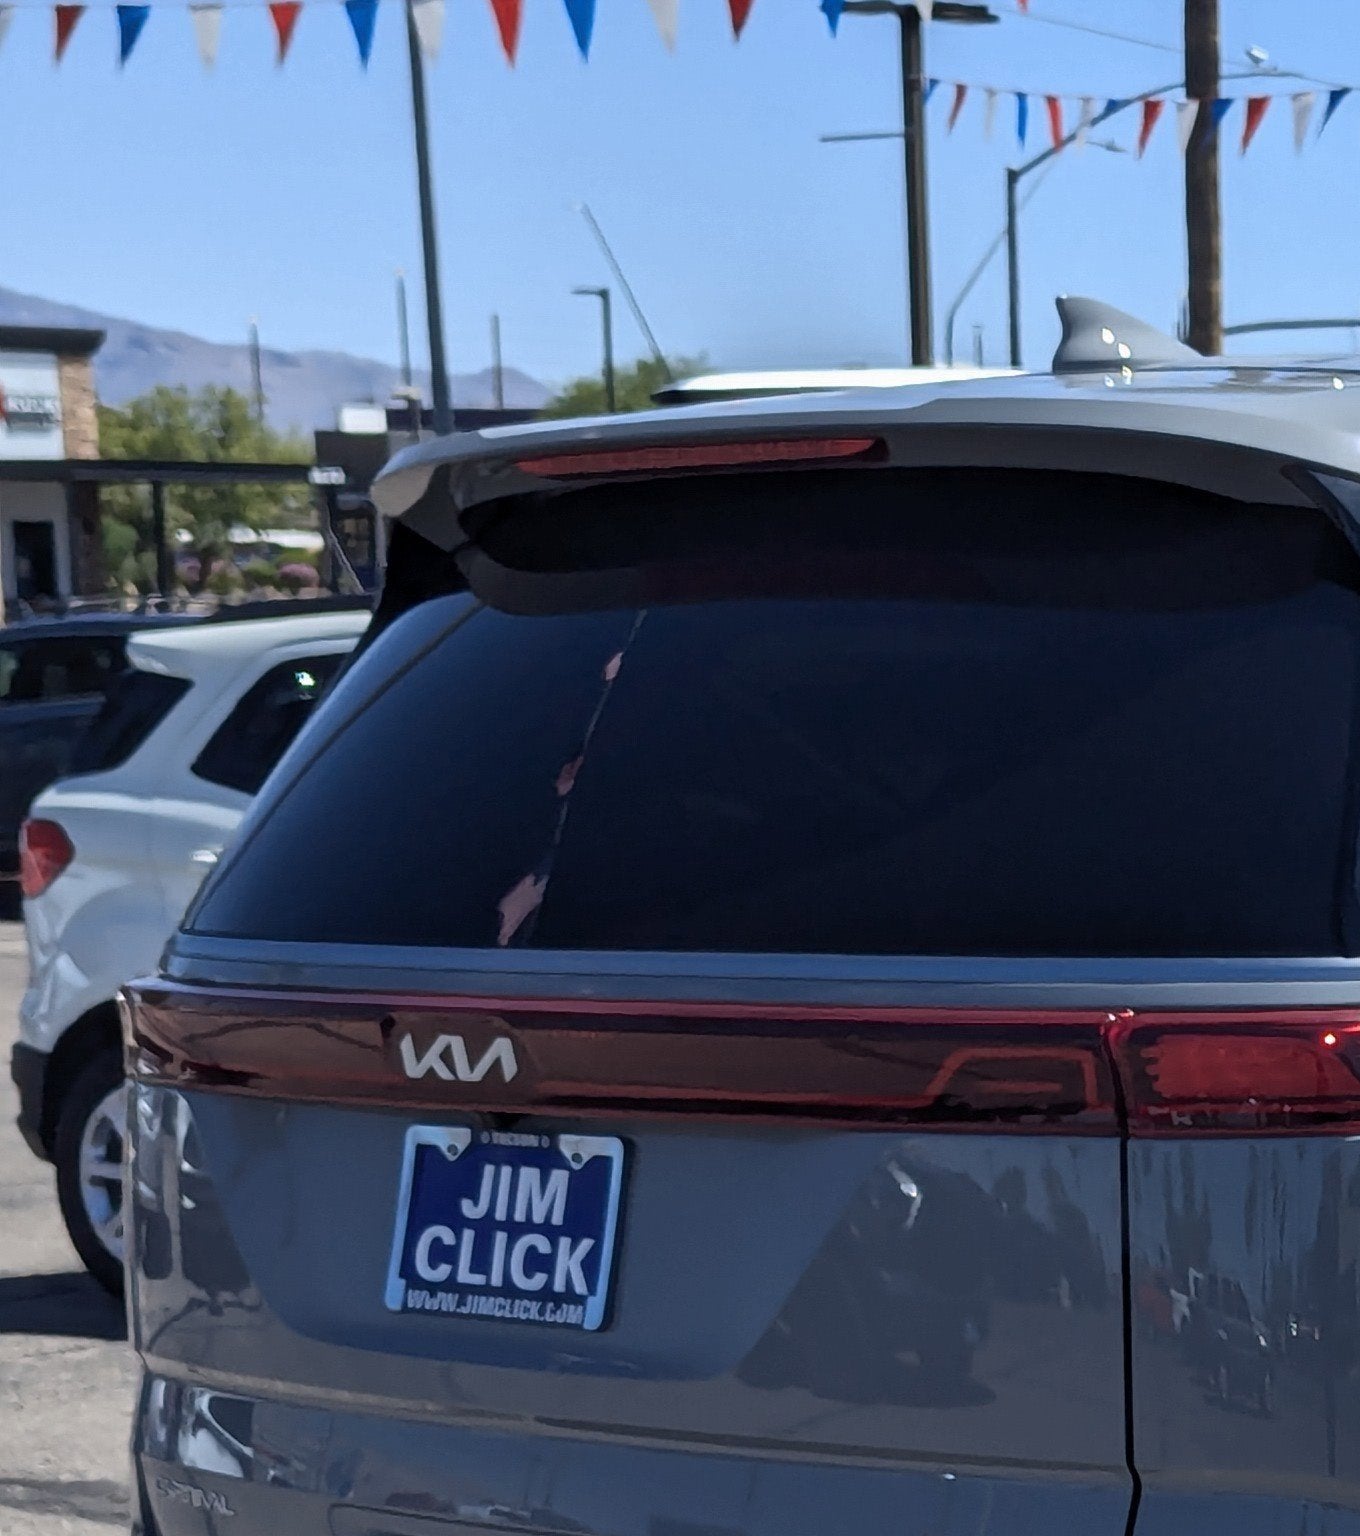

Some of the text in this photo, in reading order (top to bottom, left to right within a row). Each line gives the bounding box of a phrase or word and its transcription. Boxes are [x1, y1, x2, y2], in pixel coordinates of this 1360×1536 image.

[401, 1033, 518, 1082] KIA
[461, 1164, 569, 1225] JIM
[415, 1225, 595, 1295] CLICK
[407, 1289, 584, 1324] WWW.JIMCLICK.COM
